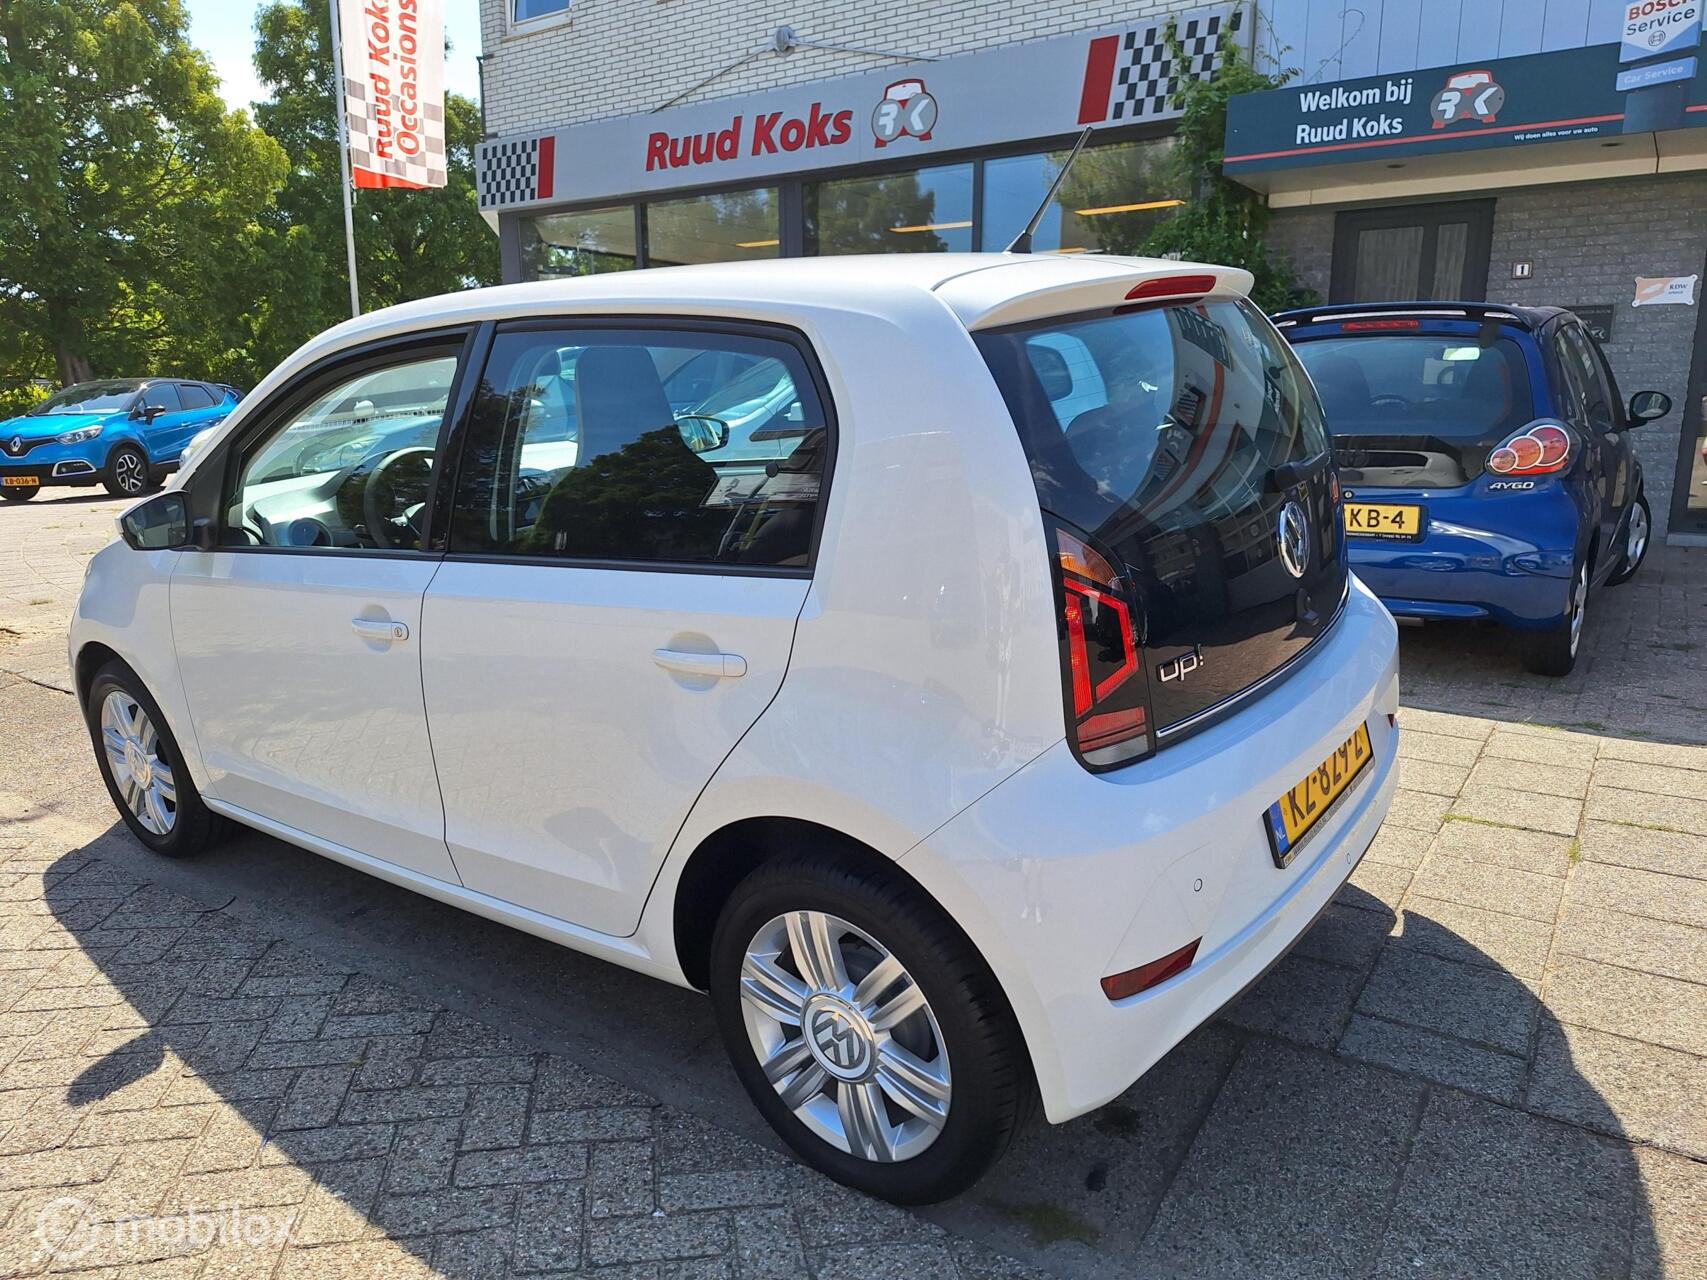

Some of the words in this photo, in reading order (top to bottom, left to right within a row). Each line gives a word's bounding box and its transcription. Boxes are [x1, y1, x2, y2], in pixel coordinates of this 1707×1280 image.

[1626, 8, 1696, 36] Service
[1628, 0, 1695, 21] BOSC
[365, 0, 390, 66] Kok
[393, 0, 420, 156] Occasions
[1623, 74, 1642, 84] Car
[1644, 66, 1685, 80] Service
[1299, 87, 1382, 113] Welkom
[1385, 78, 1414, 105] bij
[369, 72, 393, 160] Ruud
[1296, 118, 1348, 145] Ruud
[1351, 114, 1404, 139] Koks
[645, 115, 743, 172] Ruud
[751, 102, 854, 156] Koks
[1525, 132, 1541, 140] doen
[1489, 481, 1535, 490] AYGO
[1344, 508, 1405, 529] KB-4
[1287, 730, 1364, 828] KZ-829-Z
